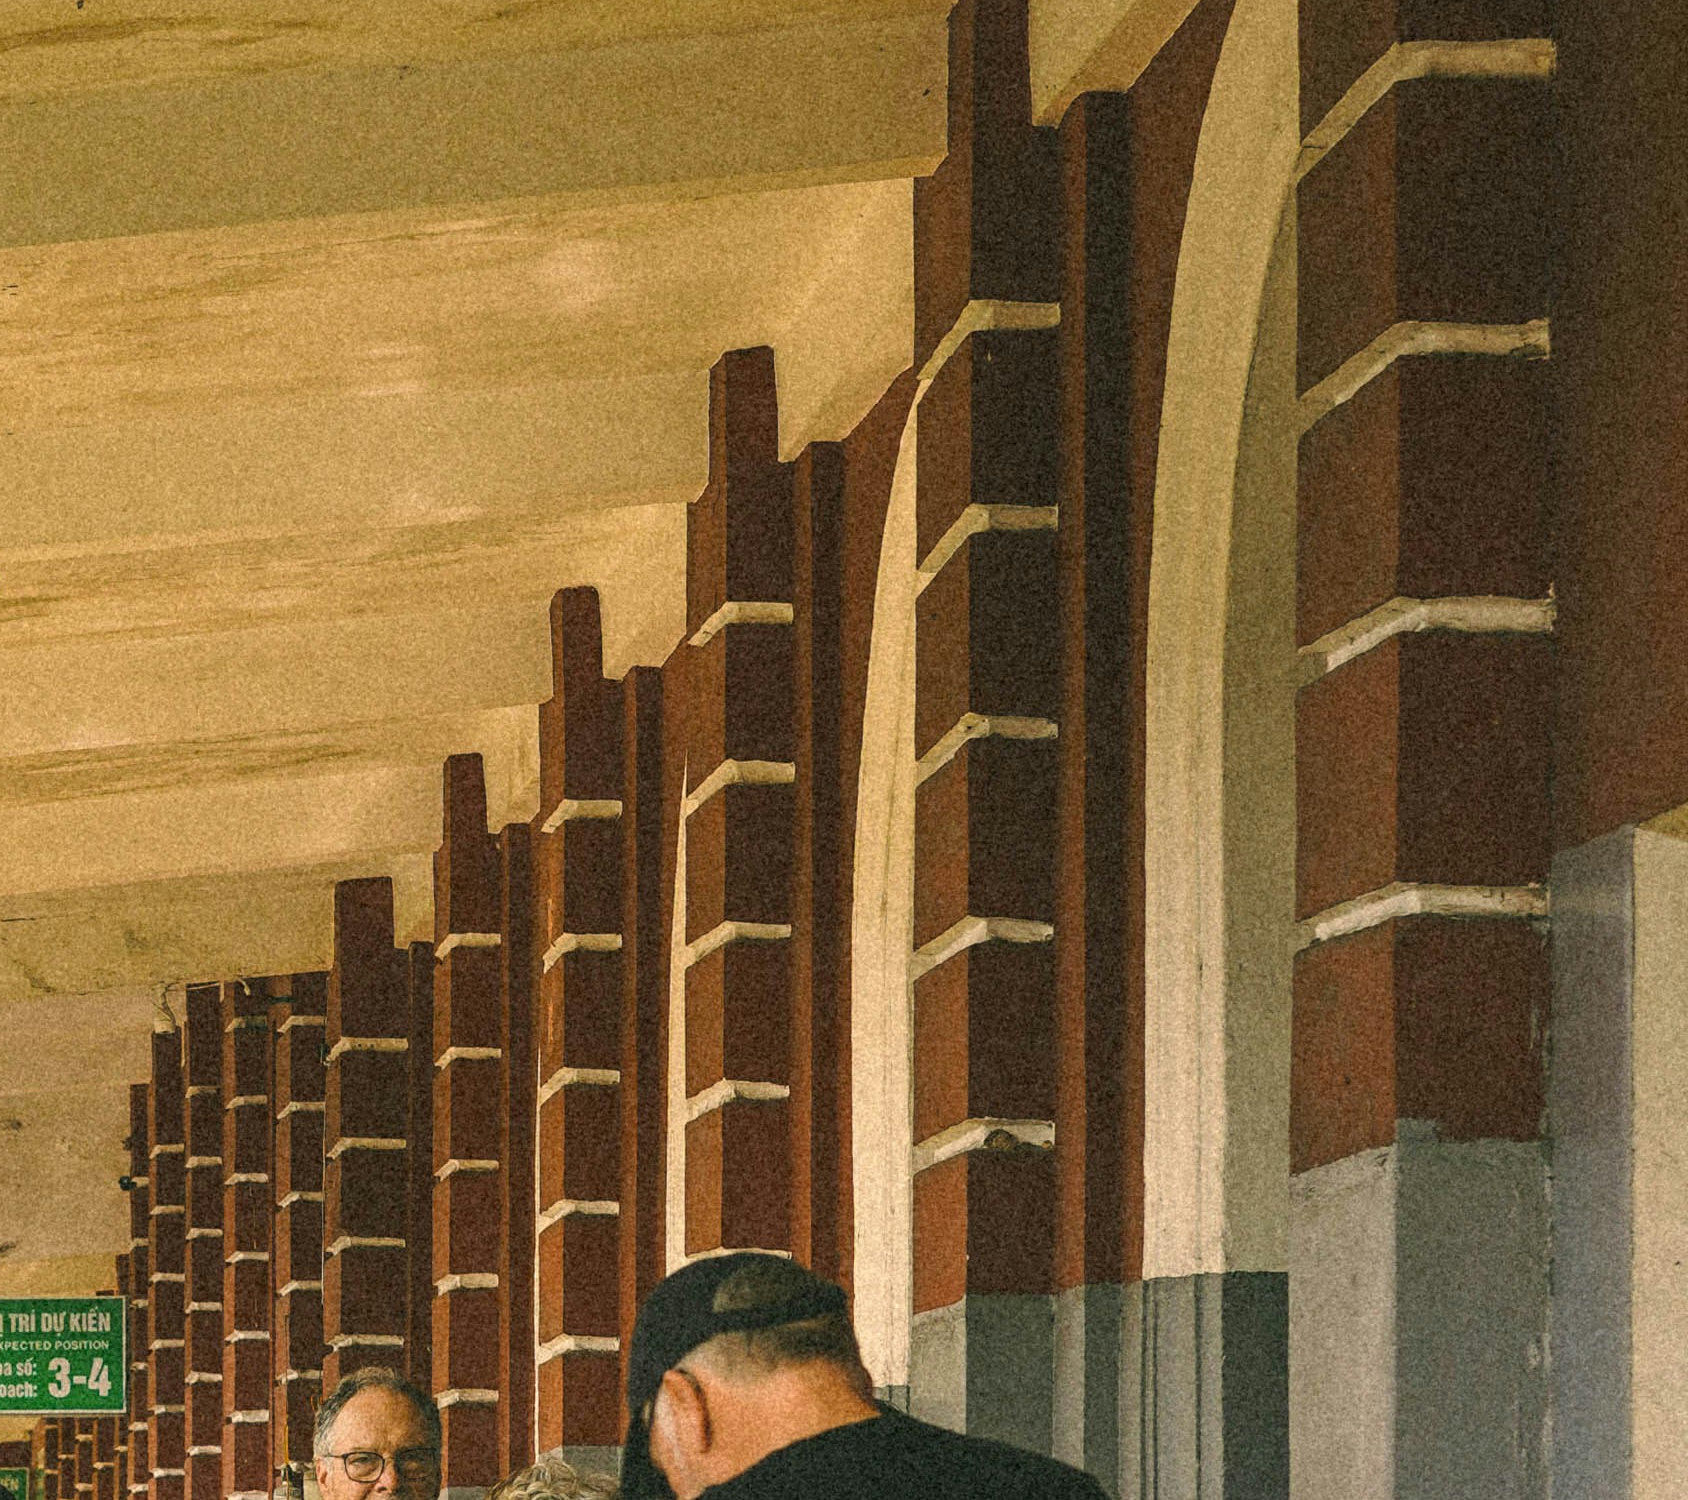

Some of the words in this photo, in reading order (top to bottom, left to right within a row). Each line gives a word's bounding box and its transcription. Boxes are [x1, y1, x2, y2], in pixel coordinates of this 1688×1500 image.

[8, 1309, 36, 1332] TRÍ
[41, 1311, 66, 1337] DỰ
[69, 1306, 111, 1332] KIẾN
[55, 1340, 109, 1350] POSITION
[16, 1357, 37, 1376] số:
[48, 1357, 111, 1398] 3-4
